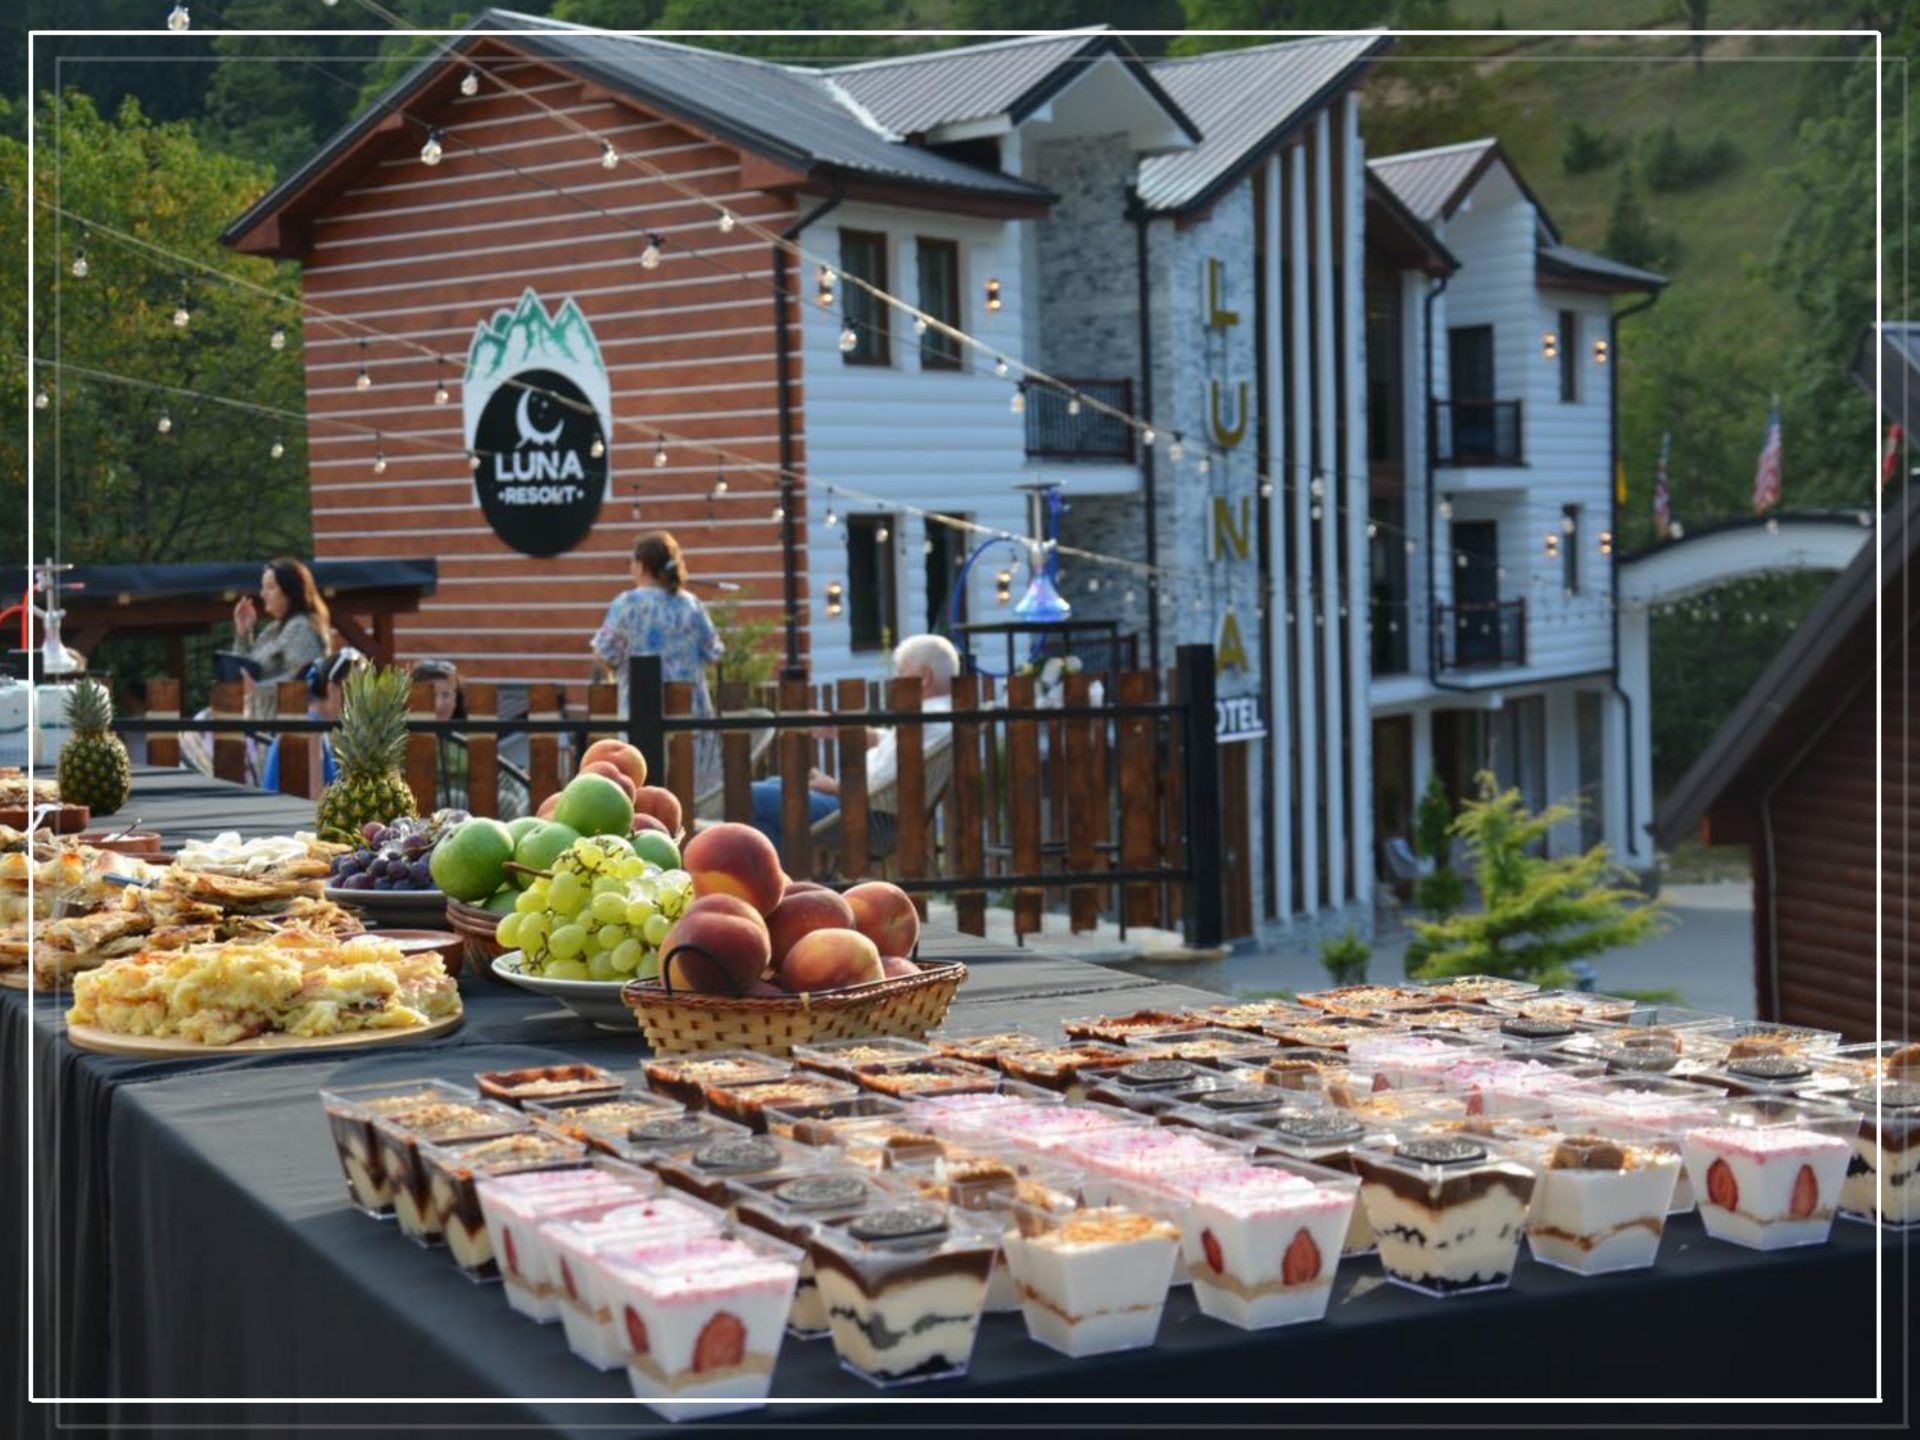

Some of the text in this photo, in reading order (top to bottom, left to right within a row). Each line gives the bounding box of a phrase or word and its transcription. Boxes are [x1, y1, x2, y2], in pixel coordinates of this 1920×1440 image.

[495, 449, 584, 481] LUNA
[1204, 256, 1250, 677] LUNA
[1215, 698, 1263, 733] OTEL
